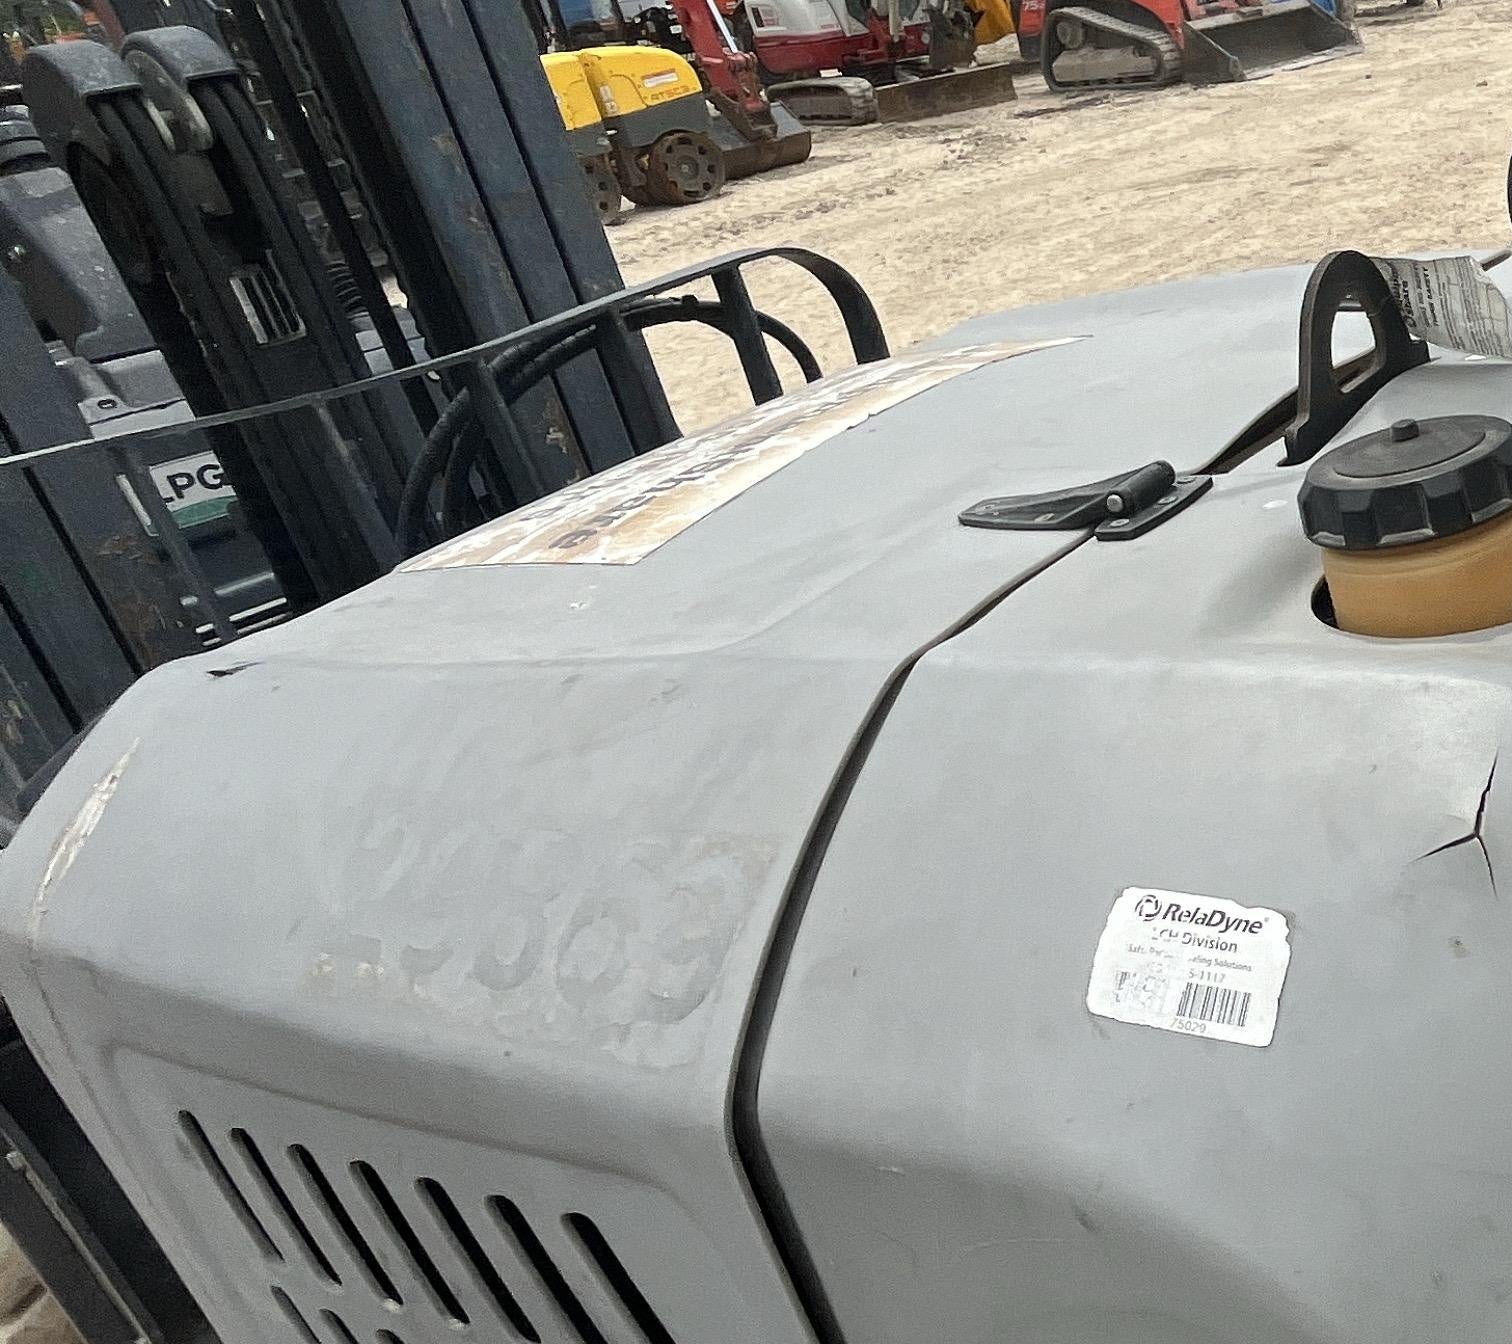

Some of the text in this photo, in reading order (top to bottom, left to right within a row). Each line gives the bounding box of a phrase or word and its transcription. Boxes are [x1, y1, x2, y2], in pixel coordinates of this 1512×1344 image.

[163, 463, 226, 504] PG
[1162, 902, 1264, 935] RelaDyne
[1181, 932, 1239, 953] Division
